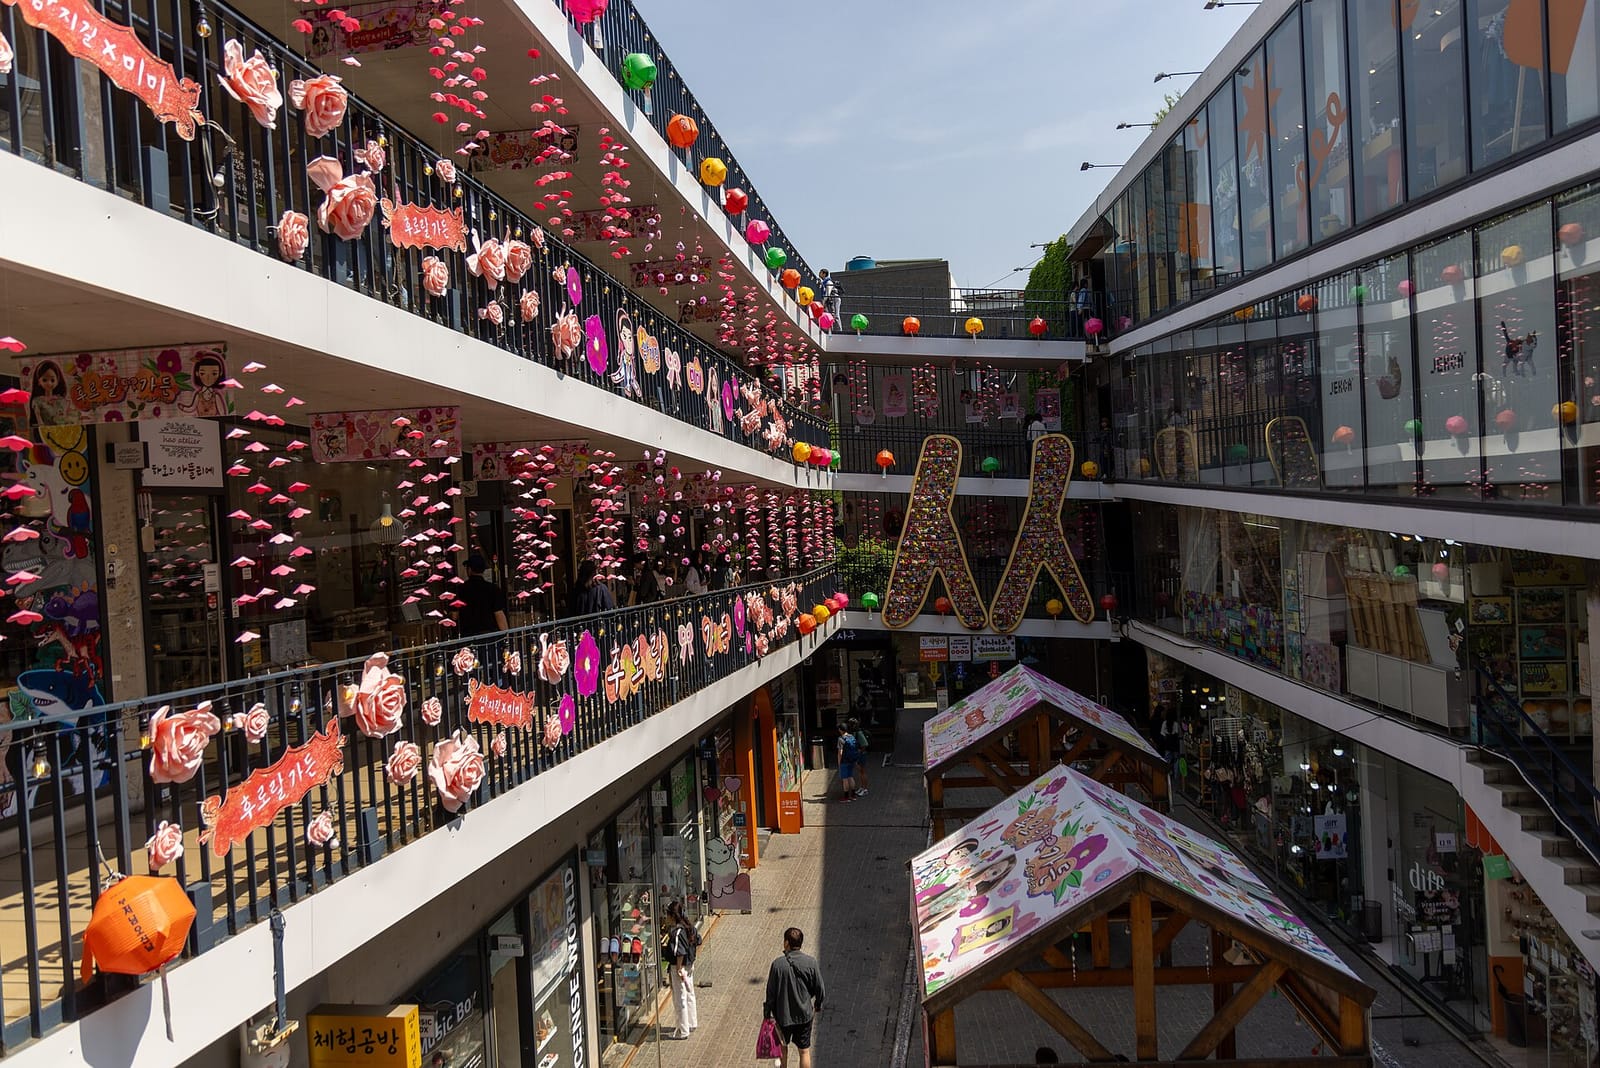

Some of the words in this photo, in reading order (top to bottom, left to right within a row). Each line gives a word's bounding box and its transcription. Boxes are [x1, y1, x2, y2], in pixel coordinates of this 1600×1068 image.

[403, 215, 430, 238] 후로랄
[431, 220, 449, 239] 가든
[76, 377, 118, 401] 후로랄
[139, 375, 172, 397] 가든
[177, 435, 201, 445] atelier
[606, 627, 664, 695] 후로랄
[239, 773, 290, 821] 후로랄
[288, 752, 318, 787] 가든
[1408, 861, 1446, 890] diff
[563, 866, 580, 974] WORLD
[313, 1027, 400, 1056] 체험공방
